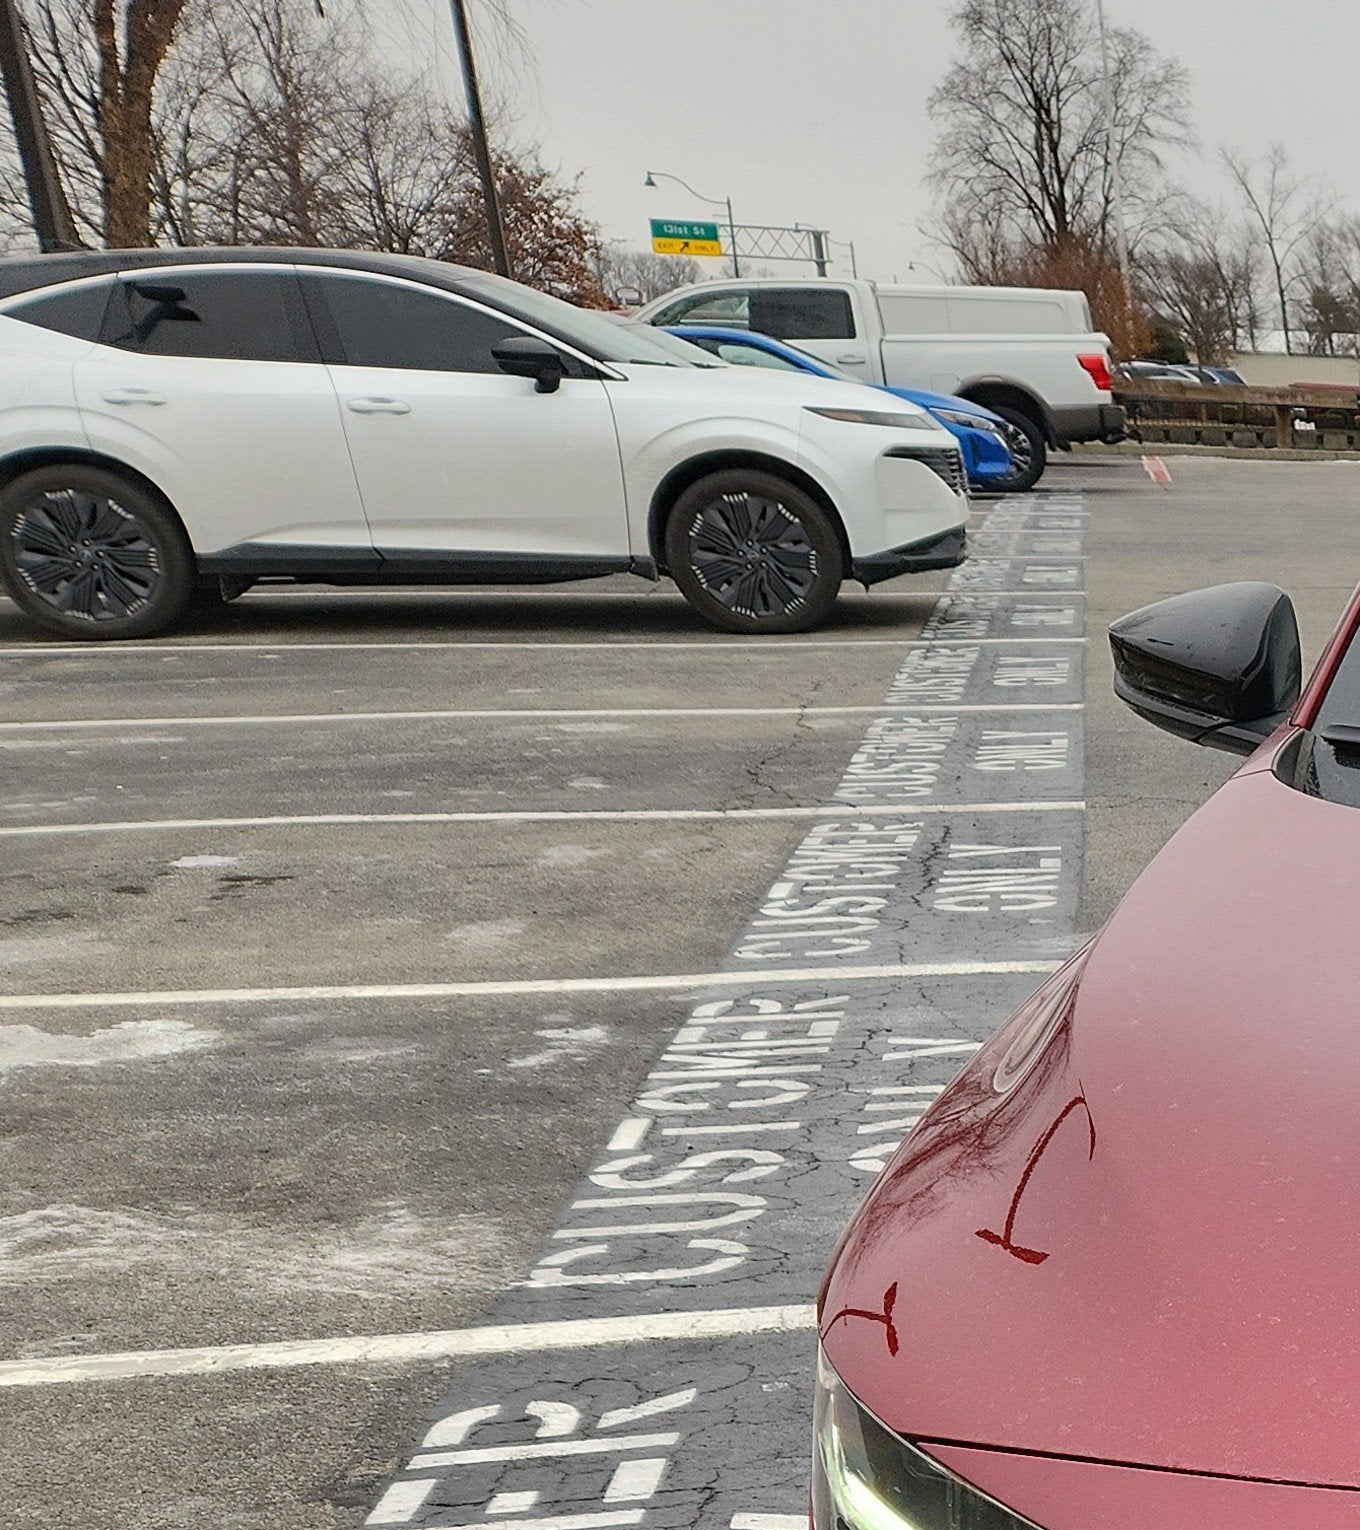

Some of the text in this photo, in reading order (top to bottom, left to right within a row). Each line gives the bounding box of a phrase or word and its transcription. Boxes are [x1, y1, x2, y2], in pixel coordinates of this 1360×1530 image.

[693, 226, 706, 235] St
[885, 647, 981, 702] CUSTOMER
[993, 657, 1069, 686] ONLY
[833, 716, 959, 798] CUSTOMER
[973, 731, 1068, 771] ONLY
[733, 821, 925, 958] CUSTOMER
[934, 844, 1061, 912] ONLY
[529, 995, 850, 1288] CUSTOMER
